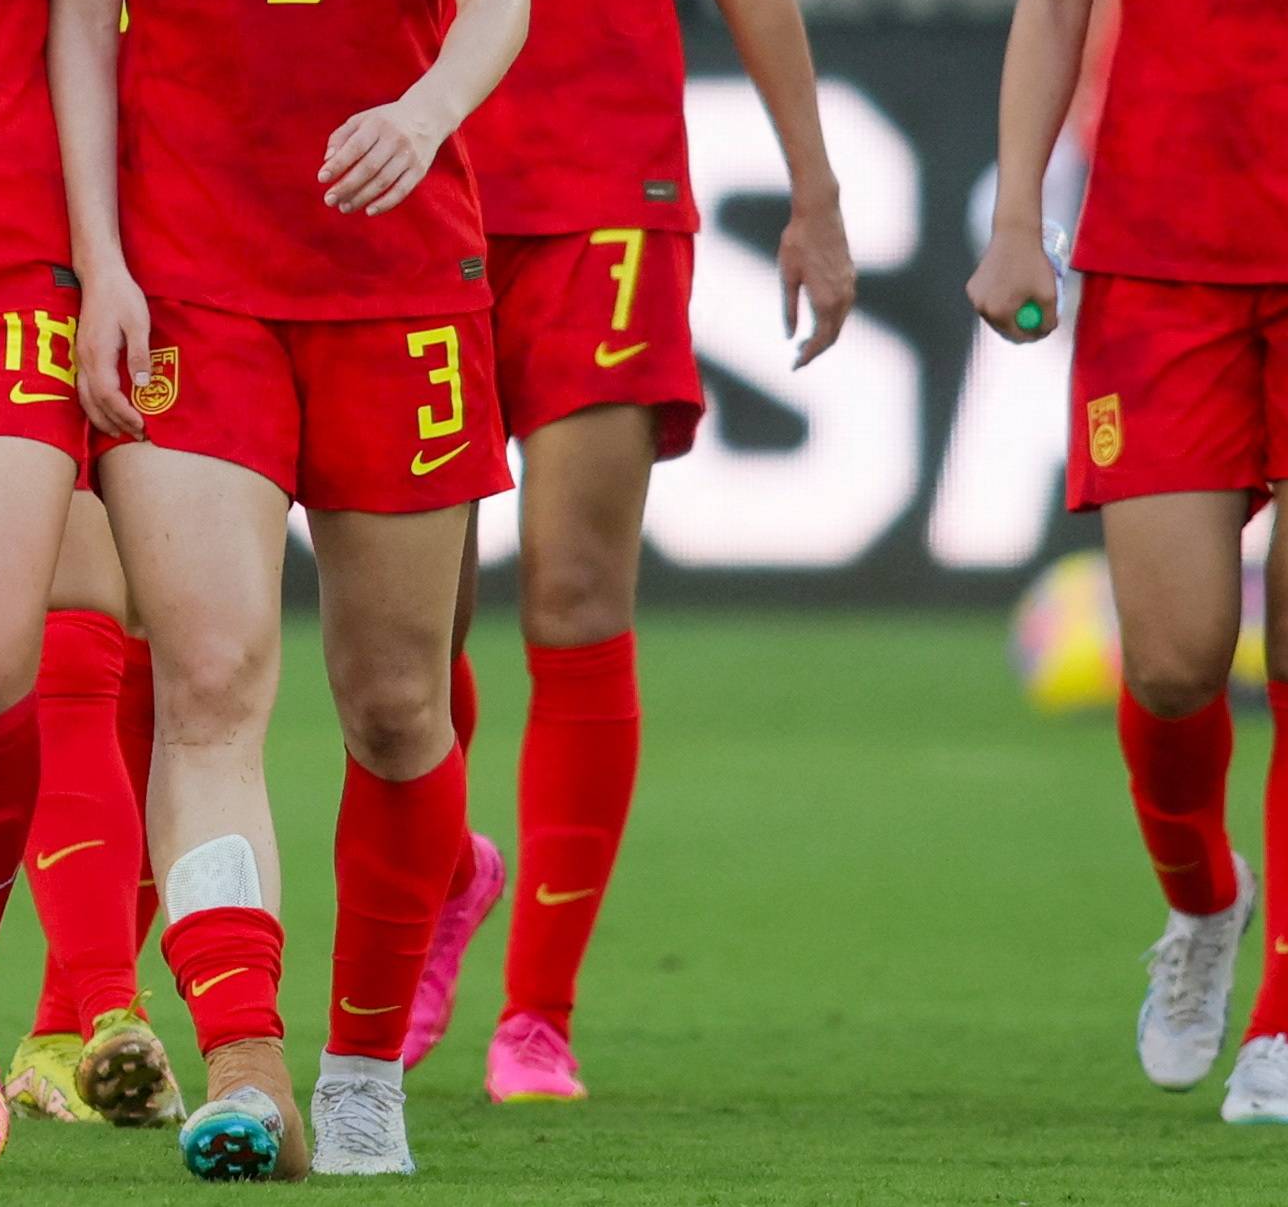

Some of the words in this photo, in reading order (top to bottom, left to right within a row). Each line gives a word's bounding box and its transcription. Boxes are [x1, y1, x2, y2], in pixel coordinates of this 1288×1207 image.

[590, 228, 644, 330] 7
[151, 351, 175, 366] FA
[406, 325, 464, 440] 3
